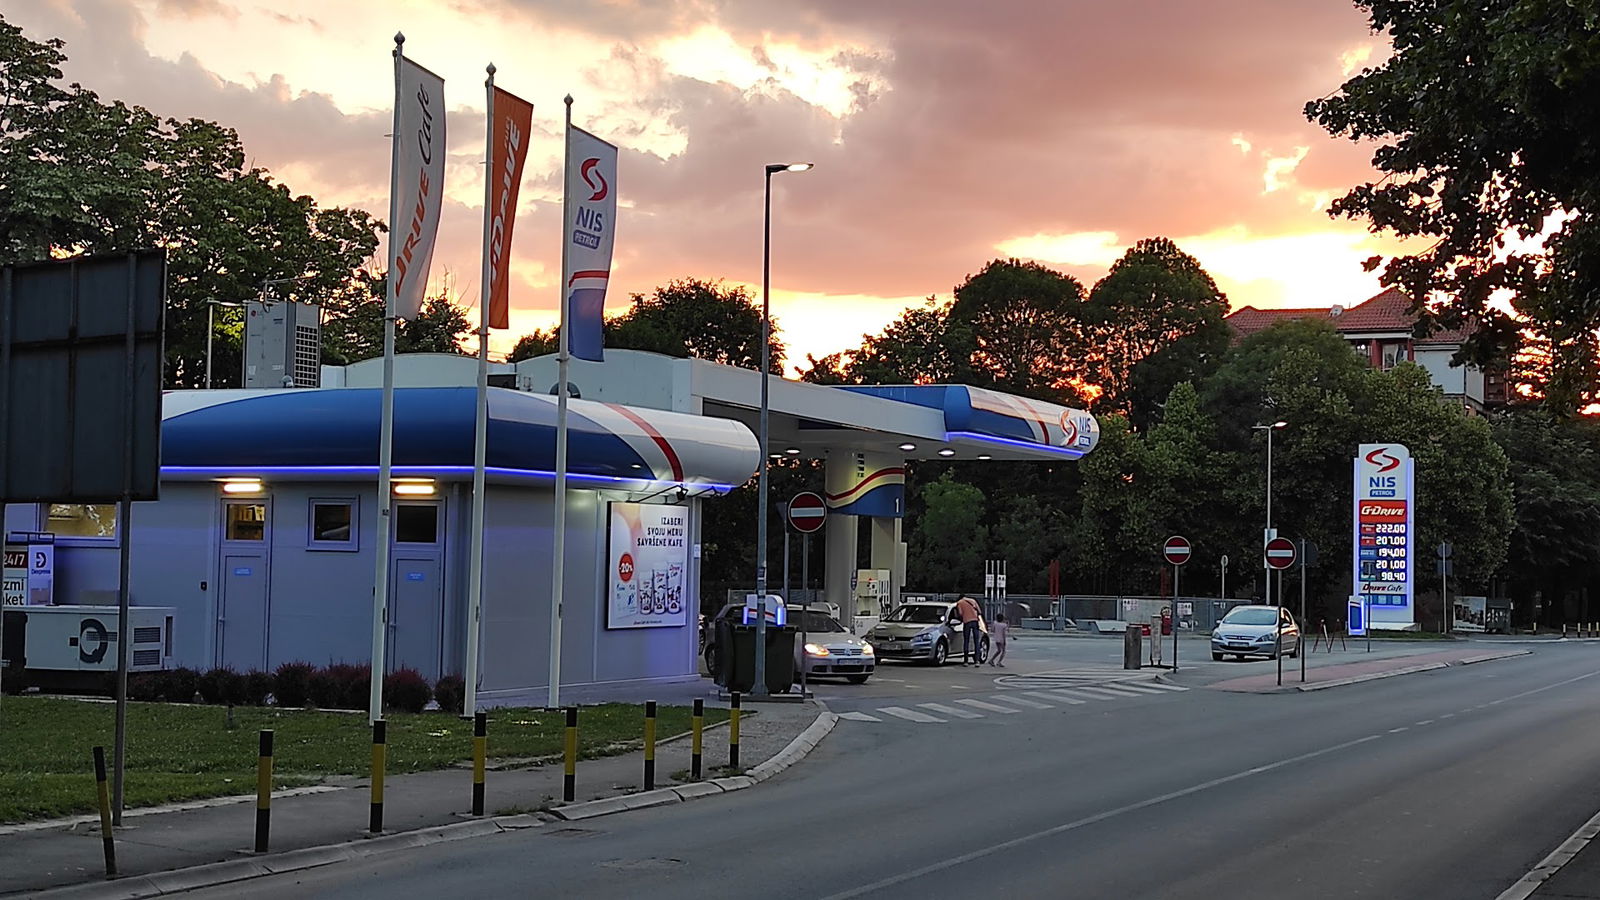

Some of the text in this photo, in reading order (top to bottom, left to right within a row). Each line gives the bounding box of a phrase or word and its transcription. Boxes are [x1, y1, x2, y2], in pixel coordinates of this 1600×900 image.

[576, 206, 603, 232] NIS
[1079, 416, 1091, 433] NIS
[1369, 476, 1396, 488] NIS
[895, 498, 900, 513] 1
[661, 517, 684, 526] IZABERI
[647, 527, 683, 537] SVOJU MERU
[637, 535, 683, 547] SAVRŠENE KAFE
[3, 593, 24, 606] ket
